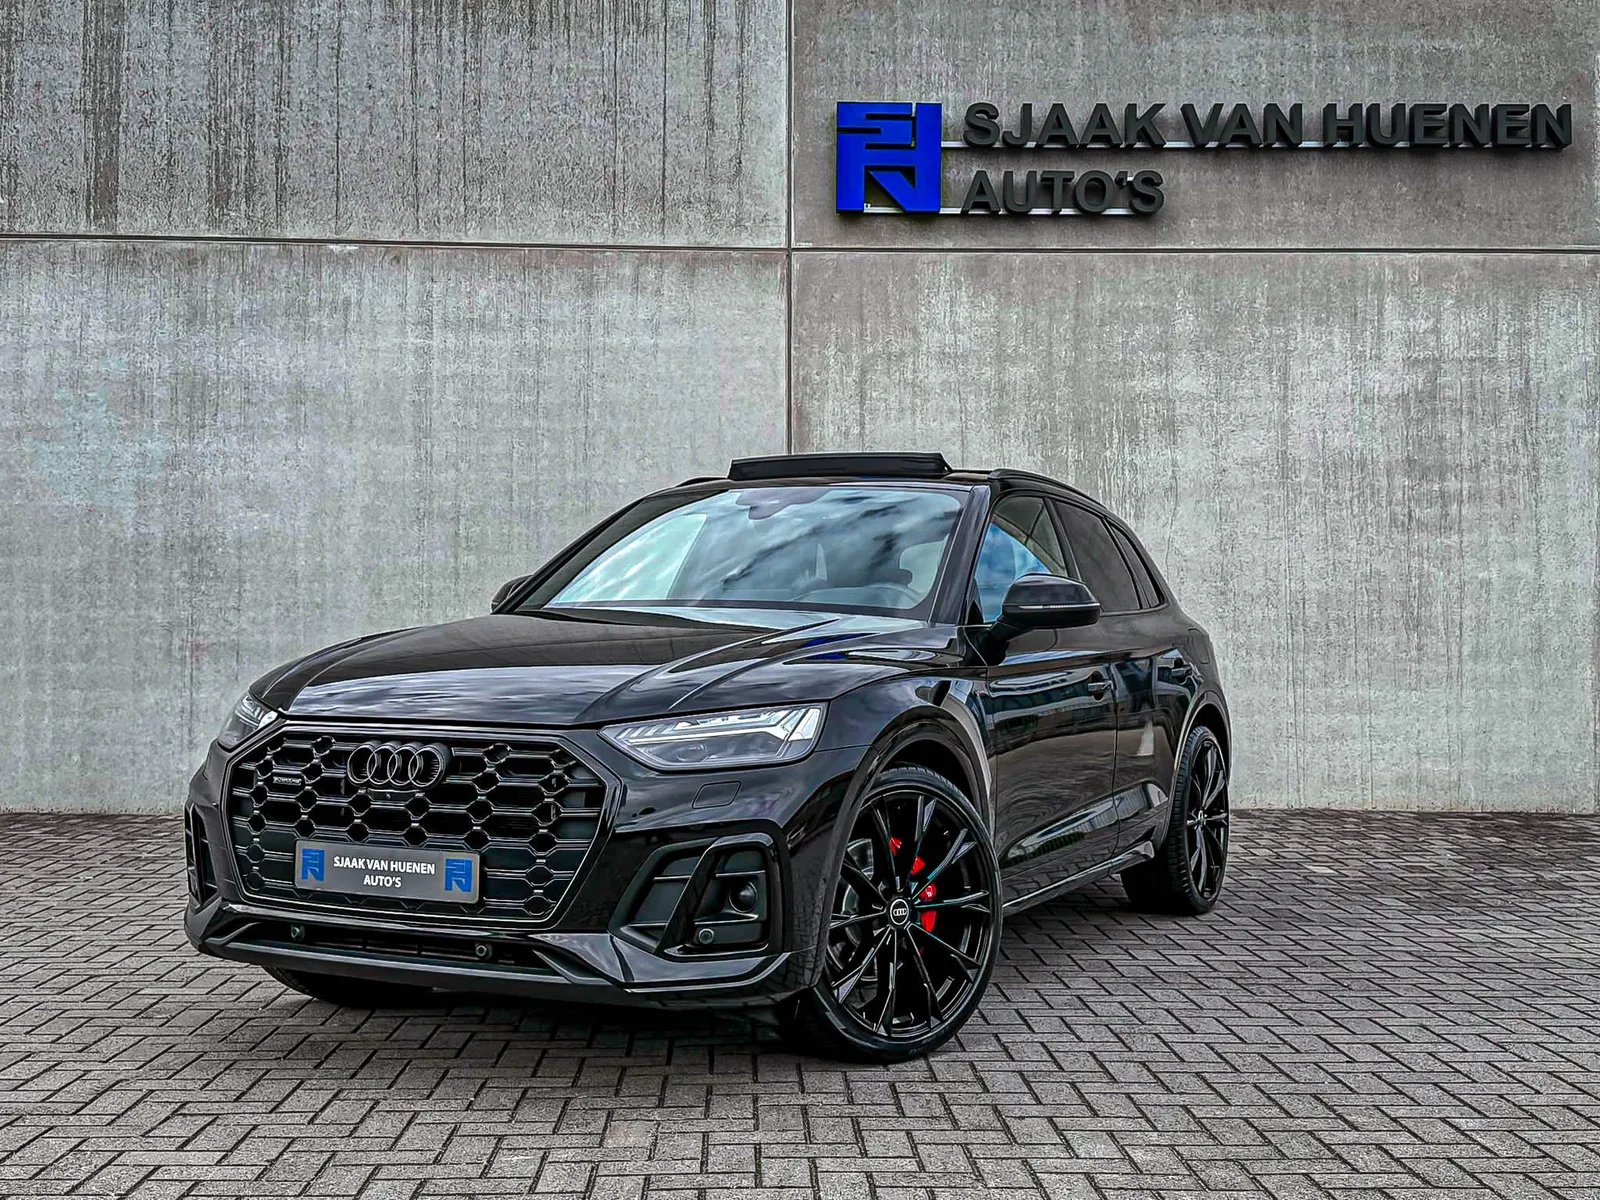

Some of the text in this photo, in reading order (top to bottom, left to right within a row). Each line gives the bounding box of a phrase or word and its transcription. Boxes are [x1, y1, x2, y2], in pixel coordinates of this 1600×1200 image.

[963, 102, 1572, 149] SJAAK VAN HUENEN
[961, 170, 1165, 215] AUTO'S
[333, 856, 435, 875] SJAAK VAN HUENEN
[363, 874, 402, 888] AUTO'S
